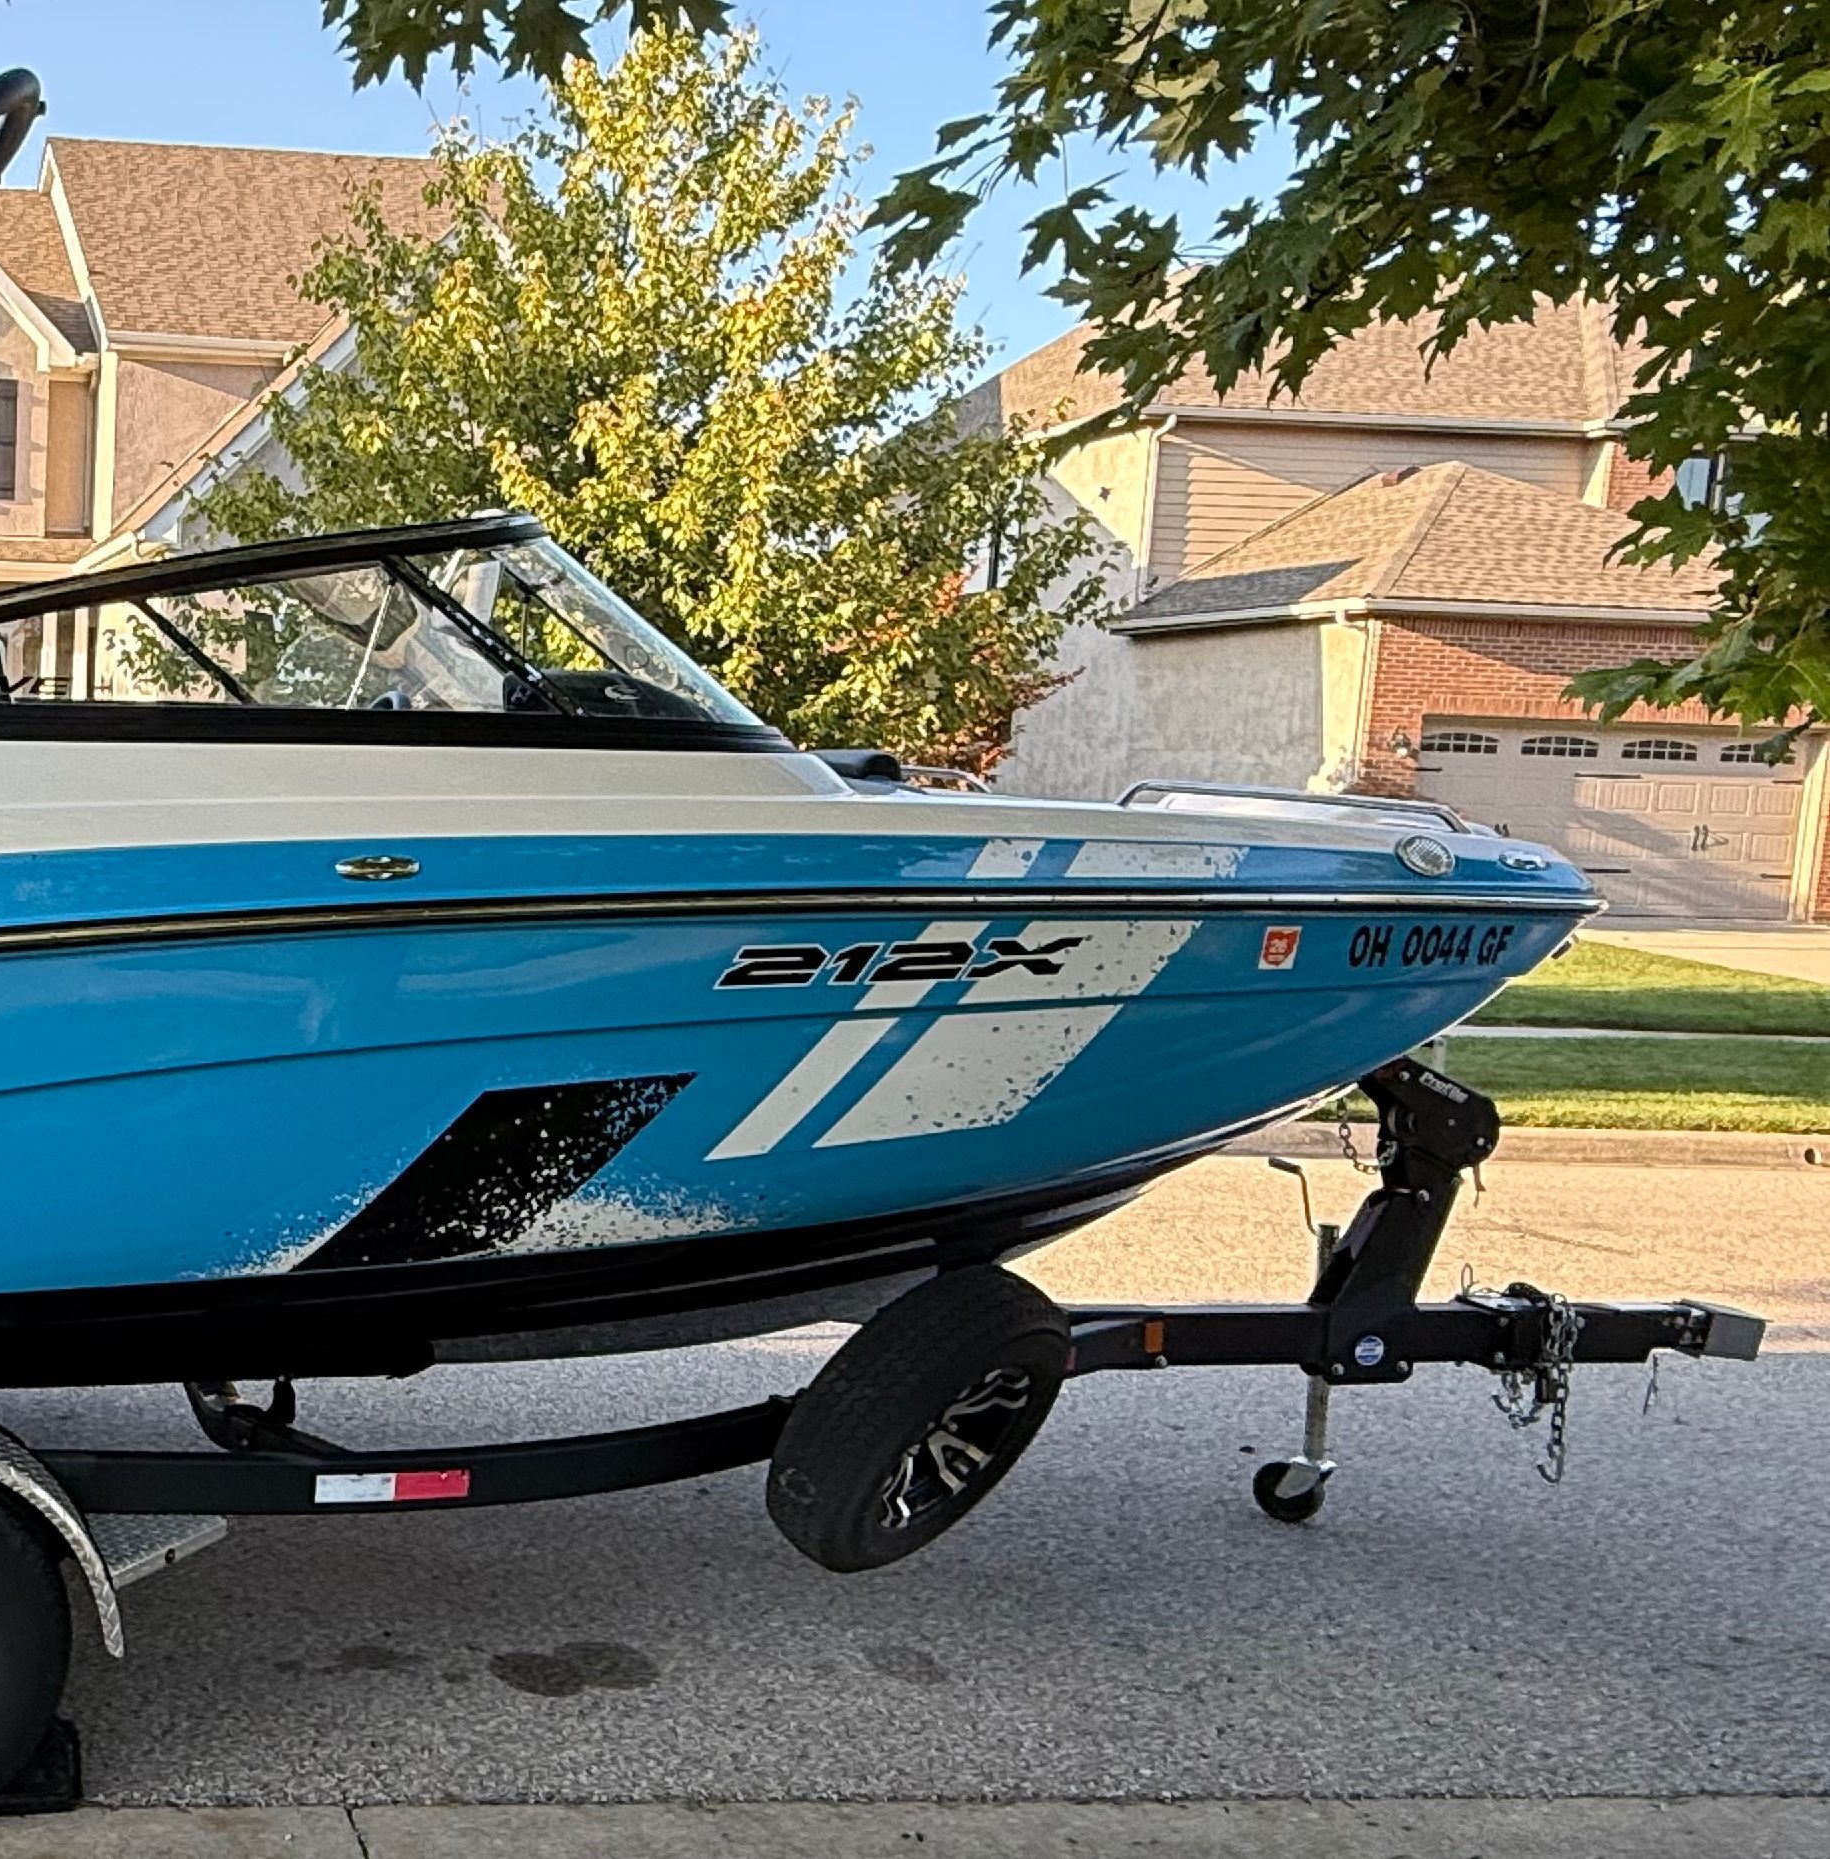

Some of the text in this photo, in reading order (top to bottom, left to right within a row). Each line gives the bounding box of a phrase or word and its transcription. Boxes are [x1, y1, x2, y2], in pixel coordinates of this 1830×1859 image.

[713, 936, 1084, 990] 212X
[1348, 924, 1515, 967] OH 0044 GF
